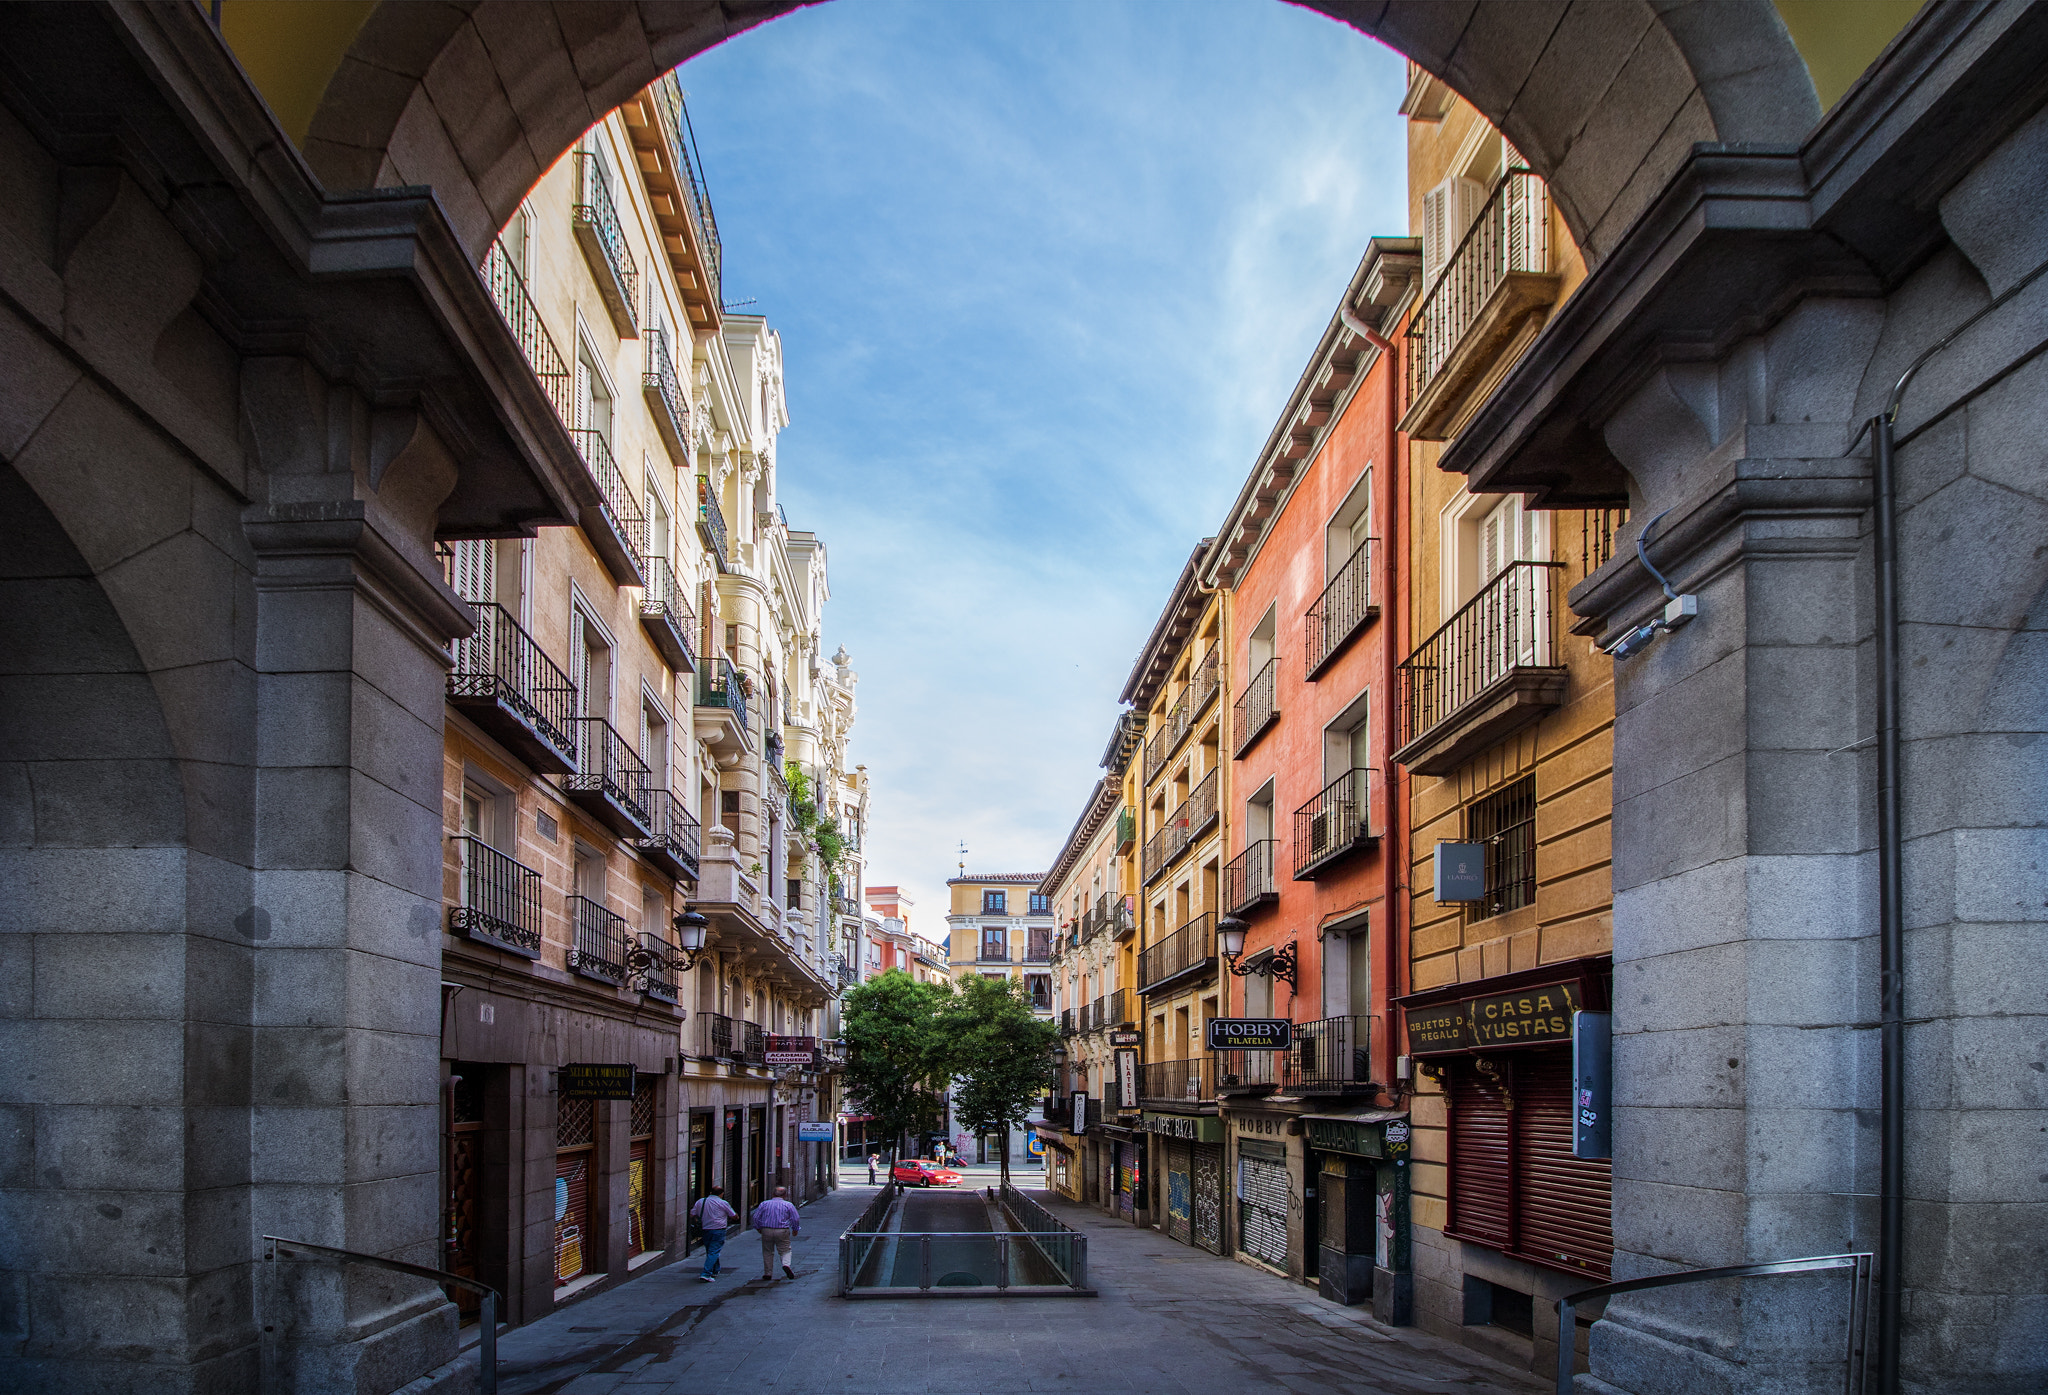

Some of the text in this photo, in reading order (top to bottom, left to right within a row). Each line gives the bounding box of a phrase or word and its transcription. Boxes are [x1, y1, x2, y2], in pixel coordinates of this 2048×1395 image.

[1485, 995, 1553, 1019] CASA
[1215, 1023, 1286, 1036] HOBBY
[1410, 1017, 1451, 1032] OBJETOS
[1482, 1016, 1566, 1040] YUSTAS
[1228, 1037, 1272, 1045] FILATELIA
[1421, 1029, 1459, 1042] REGALO
[1125, 1052, 1133, 1106] FILATELIA
[1154, 1116, 1174, 1136] LOPEZ
[1175, 1117, 1193, 1139] BAZA
[1239, 1117, 1282, 1136] HOBBY
